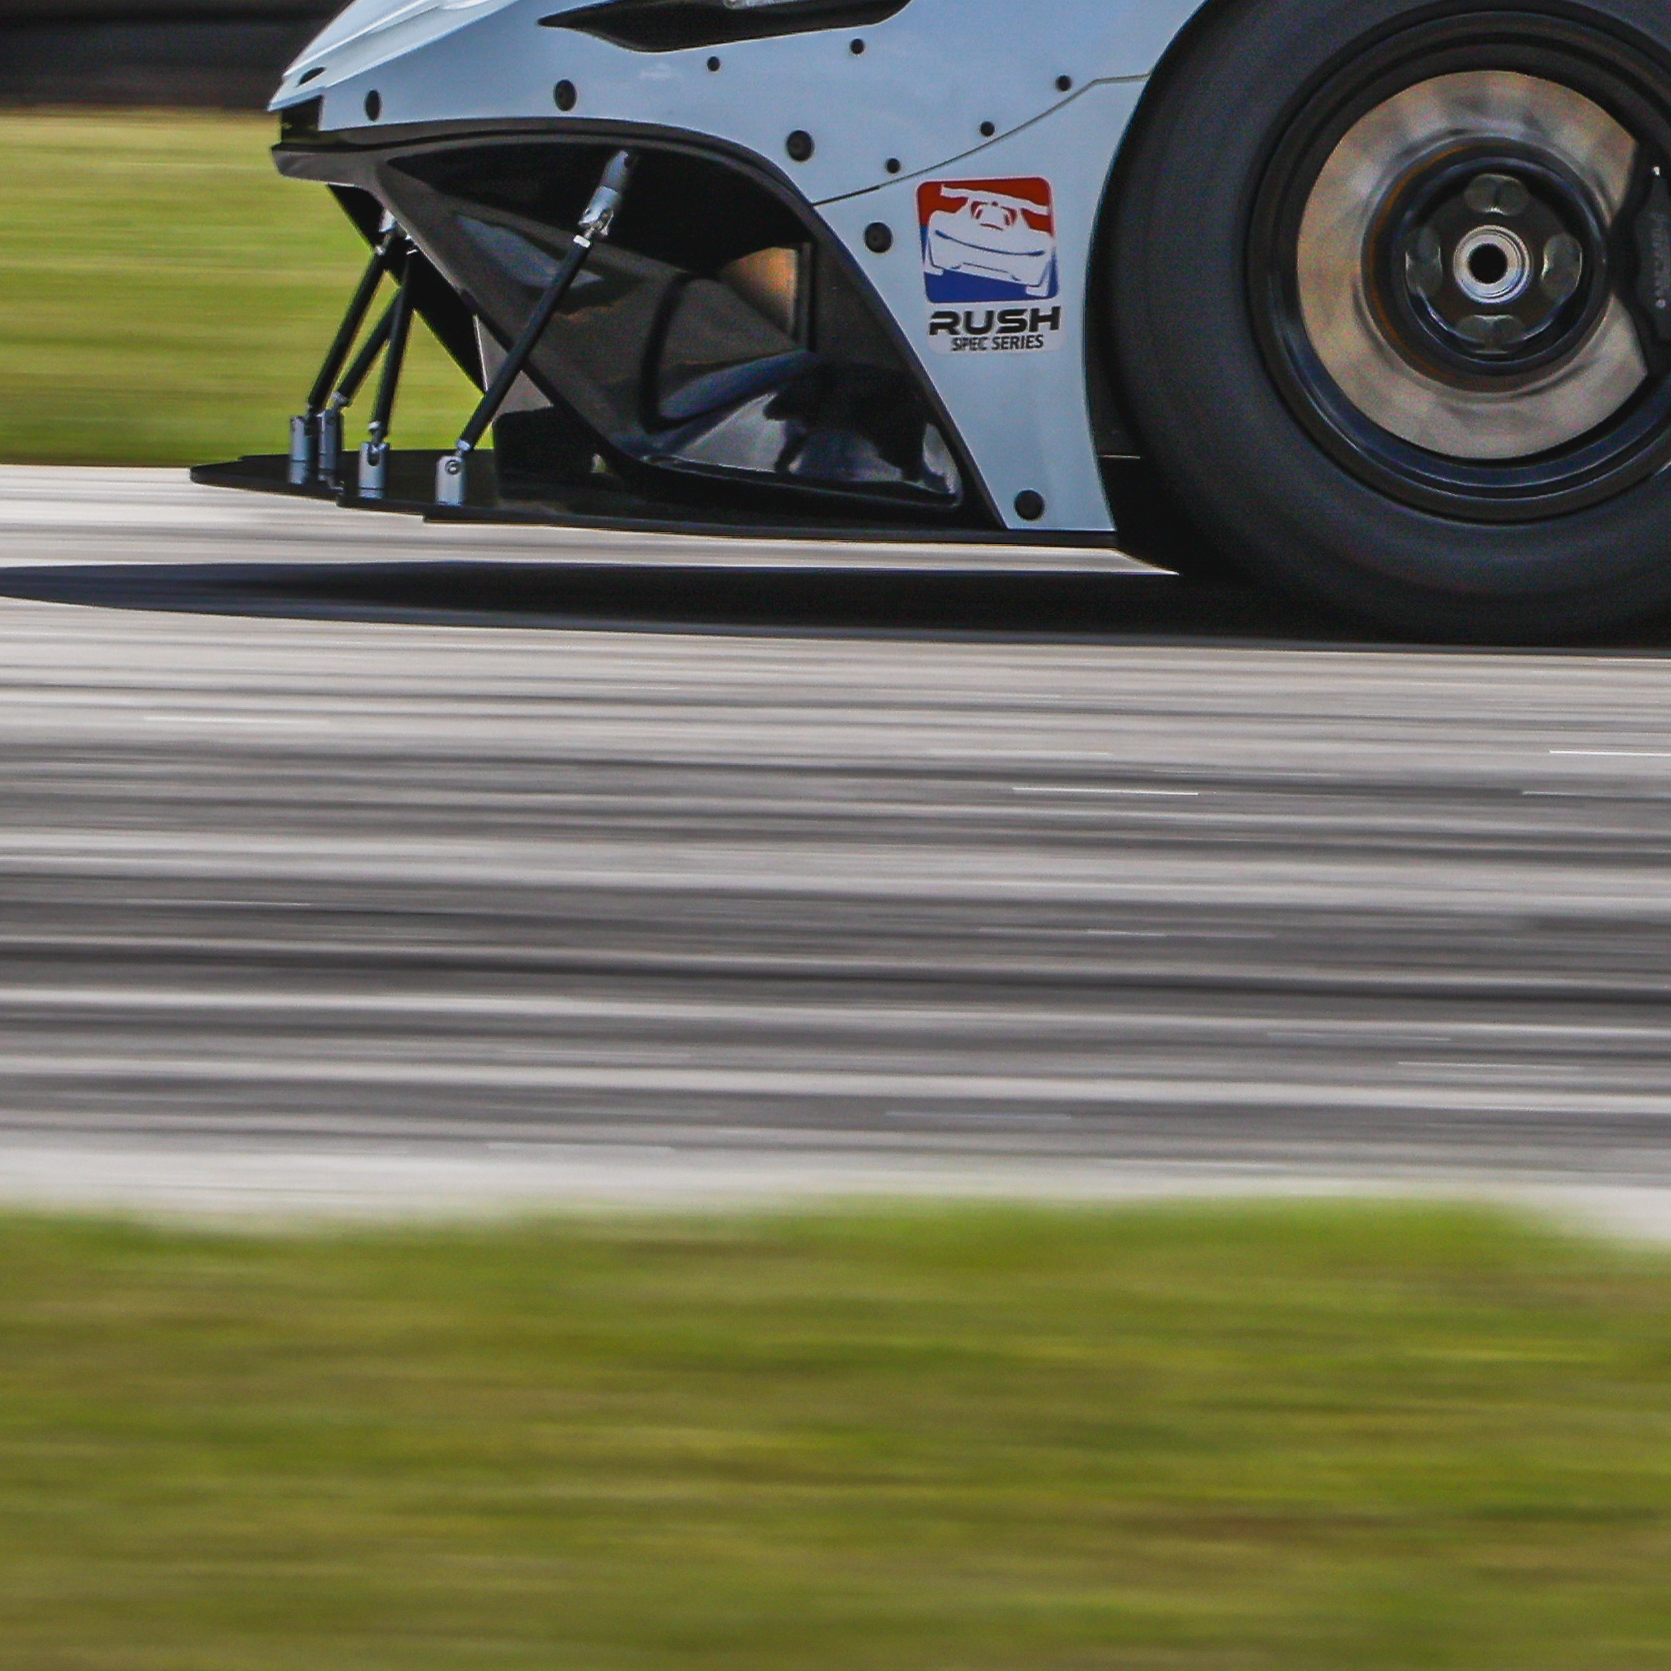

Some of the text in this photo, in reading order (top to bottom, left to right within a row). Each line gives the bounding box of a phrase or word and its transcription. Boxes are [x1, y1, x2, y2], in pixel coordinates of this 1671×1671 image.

[929, 306, 1061, 336] RUSH
[951, 334, 1044, 352] SPEC SERIES
